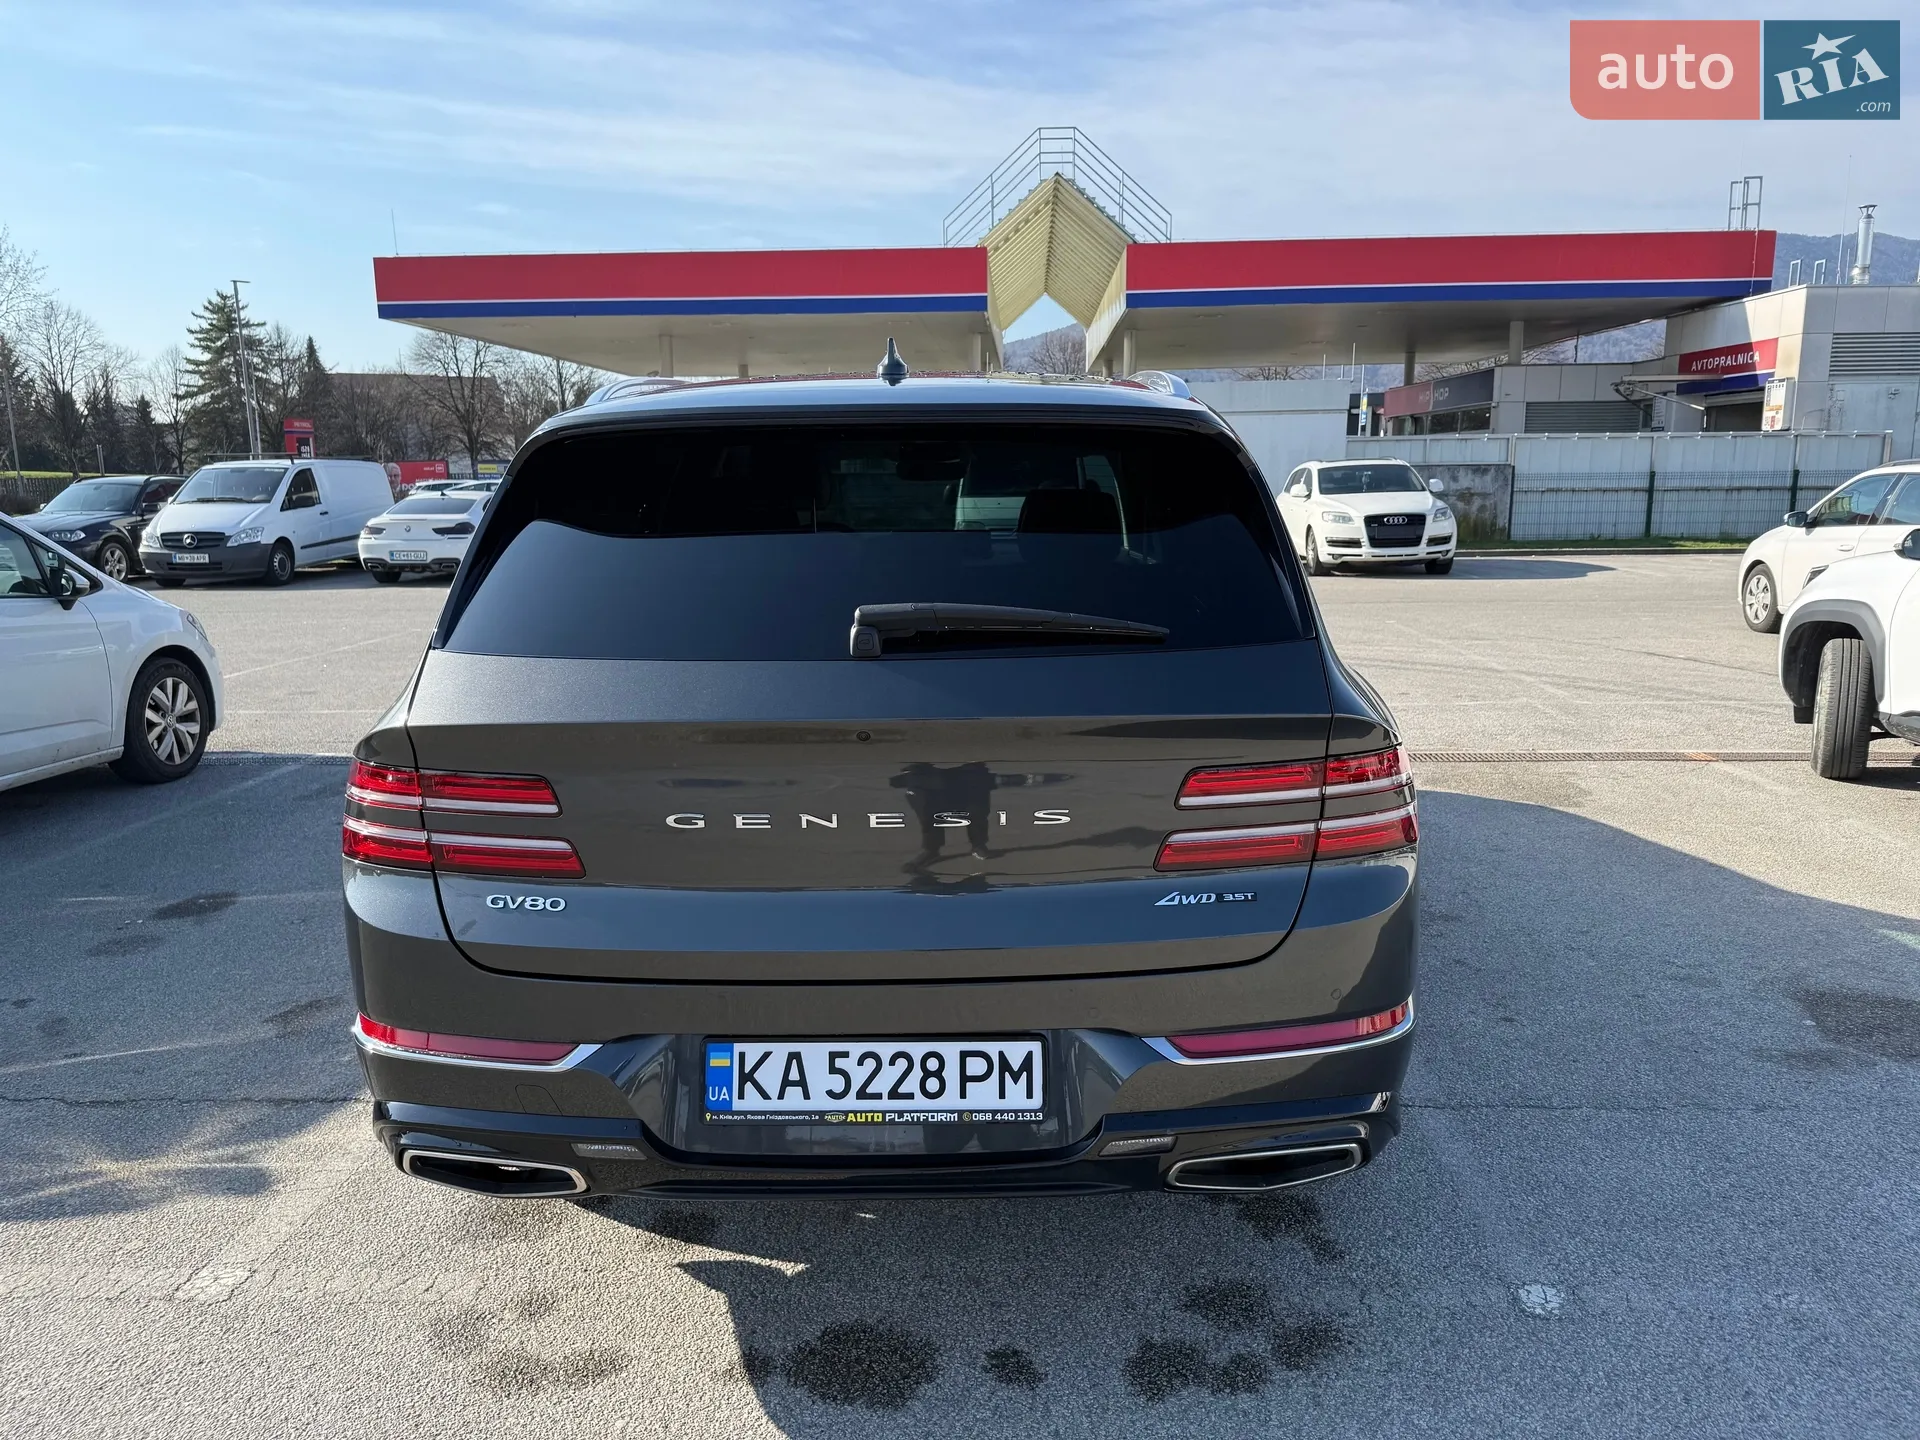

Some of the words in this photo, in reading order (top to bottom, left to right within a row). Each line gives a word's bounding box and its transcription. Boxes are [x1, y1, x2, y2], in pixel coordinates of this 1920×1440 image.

[1691, 350, 1760, 372] AVTOPRALNICA
[665, 808, 1072, 830] GENESIS
[486, 894, 566, 912] GV80
[1154, 891, 1217, 906] 4WD
[1222, 892, 1255, 901] 3.5T
[737, 1051, 811, 1101] KA
[825, 1050, 947, 1101] 5228
[958, 1050, 1034, 1100] PM
[708, 1086, 730, 1102] UA
[847, 1112, 883, 1122] AUTO
[885, 1112, 959, 1122] PLATFORM
[972, 1112, 993, 1121] 068
[994, 1112, 1015, 1121] 440
[1017, 1112, 1043, 1121] 1313
